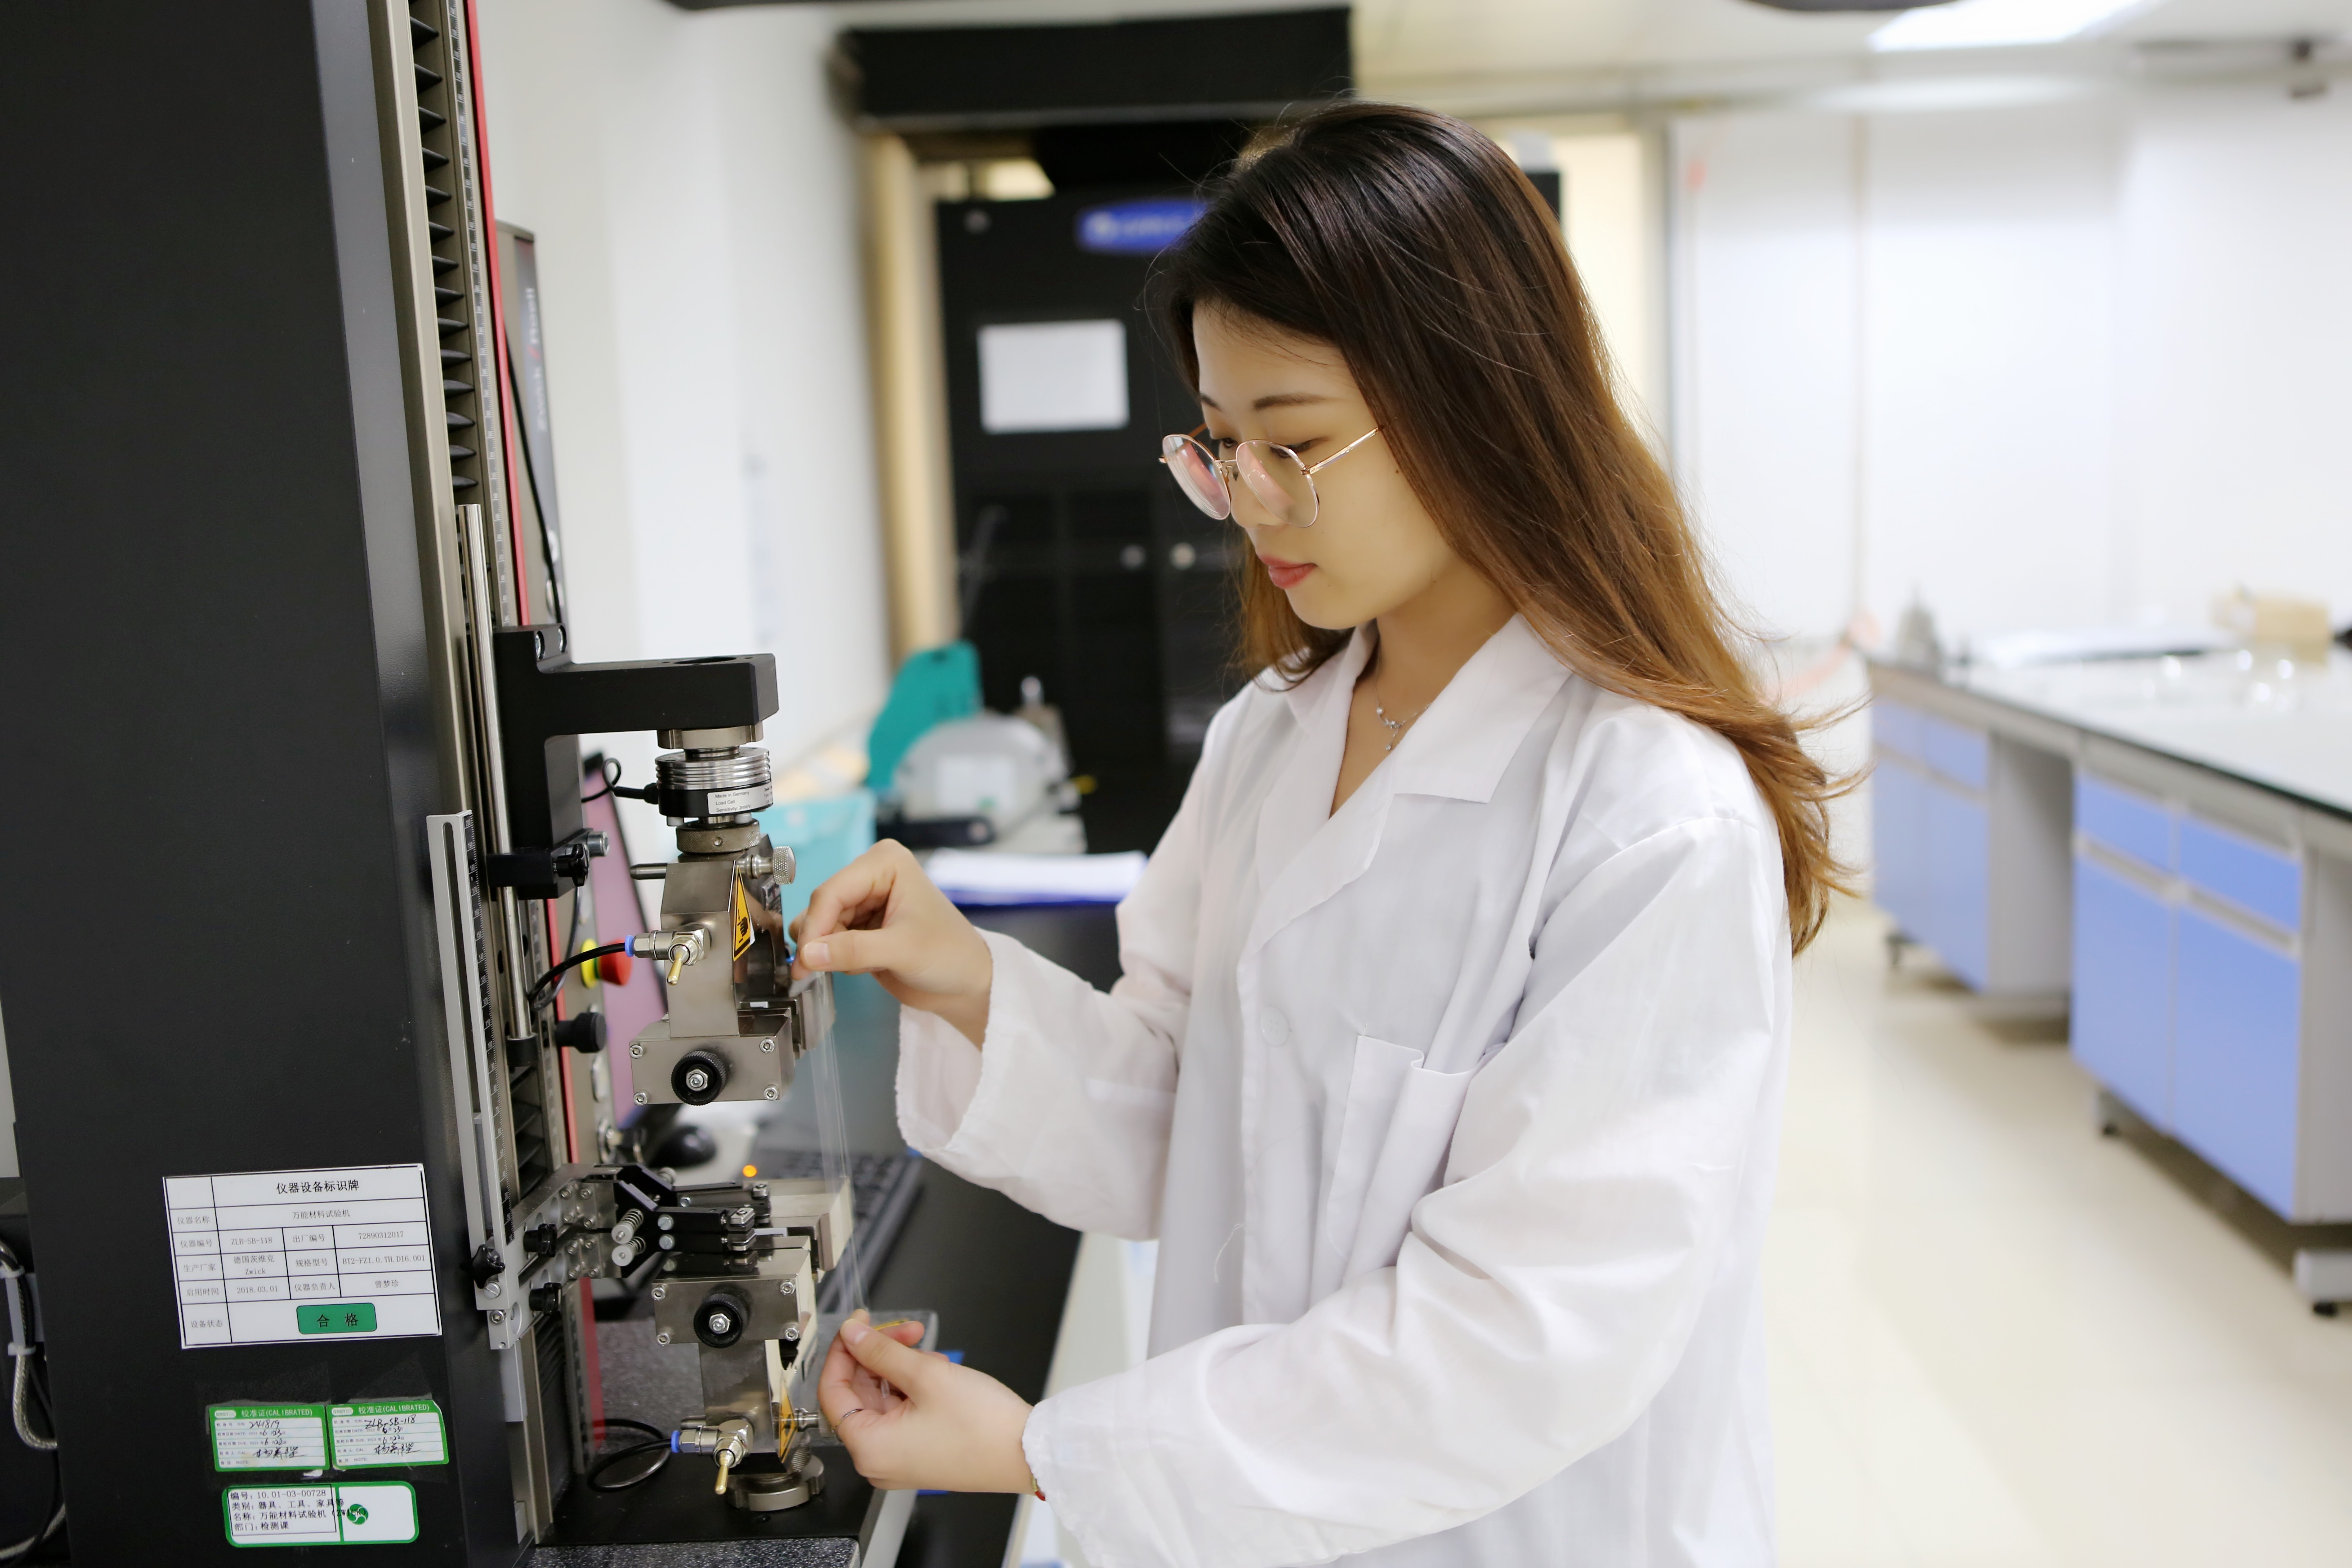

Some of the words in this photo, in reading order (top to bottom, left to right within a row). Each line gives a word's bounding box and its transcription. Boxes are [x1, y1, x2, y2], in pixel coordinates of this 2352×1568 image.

[276, 1179, 359, 1194] 仪器设备标识牌
[177, 1216, 210, 1225] 仪器名称
[292, 1209, 350, 1219] 万能材料试验机
[180, 1239, 213, 1248] 仪器编号
[231, 1237, 272, 1245] ZLB-SB-118
[293, 1234, 325, 1243] 出厂编号
[234, 1254, 275, 1264] 德国茨维克
[296, 1258, 328, 1267] 规格型号
[184, 1263, 216, 1272] 生产厂家
[187, 1287, 219, 1296] 启用时间
[236, 1285, 278, 1294] 2018.03.01
[294, 1282, 336, 1292] 仪器负责人
[375, 1280, 399, 1288] 曾梦珍
[191, 1320, 223, 1328] 设备状态
